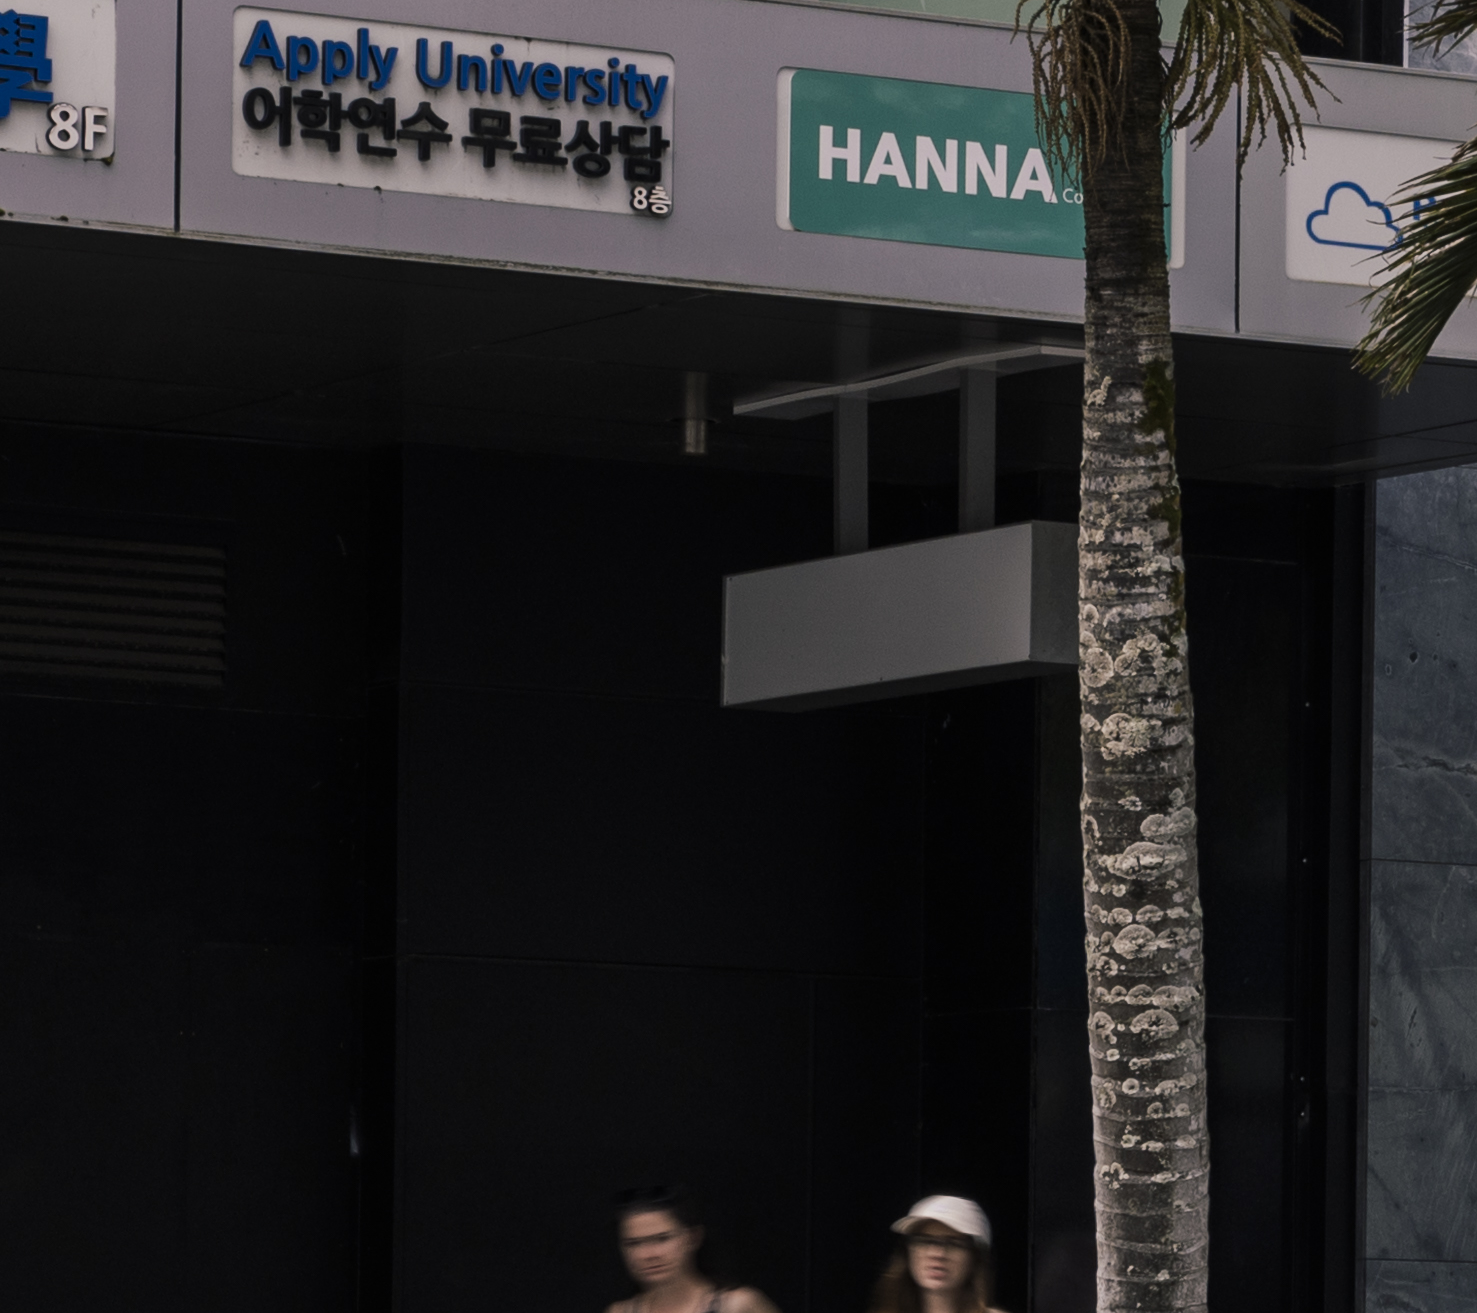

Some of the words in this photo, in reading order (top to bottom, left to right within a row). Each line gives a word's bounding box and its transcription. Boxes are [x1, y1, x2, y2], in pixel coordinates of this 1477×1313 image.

[239, 19, 399, 89] Apply
[415, 37, 669, 119] University
[46, 102, 109, 152] 8F
[242, 86, 453, 162] 어학연수
[461, 107, 670, 183] 무료상담
[818, 124, 1058, 204] HANNA
[630, 185, 671, 215] 8층
